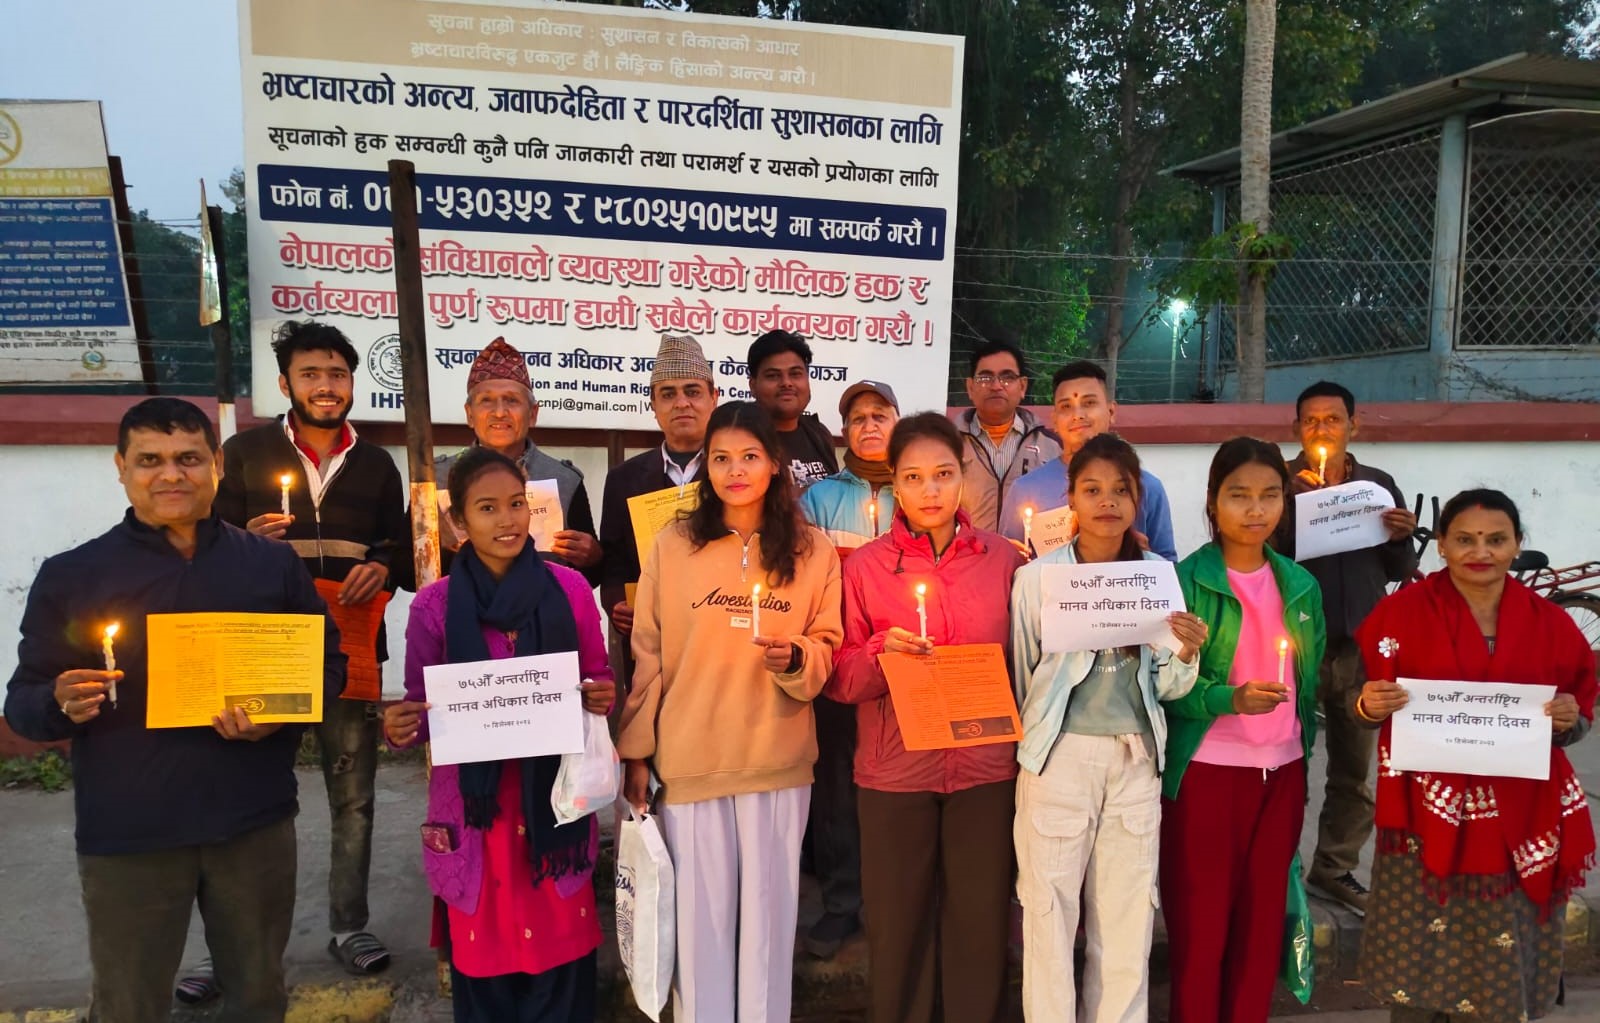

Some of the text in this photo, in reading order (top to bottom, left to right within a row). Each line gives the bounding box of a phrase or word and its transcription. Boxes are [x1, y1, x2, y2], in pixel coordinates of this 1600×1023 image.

[426, 14, 475, 34] सूचना
[480, 15, 515, 35] हाम्रो
[521, 17, 584, 39] अधिकार
[601, 27, 660, 48] सुशासन
[665, 32, 678, 46] र
[682, 29, 750, 52] विकासको
[756, 38, 801, 56] आधार
[523, 49, 577, 71] एकजुट
[670, 56, 723, 79] हिंसाको
[729, 65, 776, 82] अन्त्य
[262, 72, 944, 146] भ्रष्टाचारको अन्त्य, जवाफदेहिता र पारदर्शिता सुशासनका लागि
[268, 125, 348, 150] सूचनाको
[354, 132, 389, 153] हक
[473, 134, 509, 163] कुनै
[515, 137, 550, 160] पनि
[556, 143, 633, 167] जानकारी
[640, 149, 676, 169] तथा
[683, 151, 745, 174] परामर्श
[750, 156, 762, 175] र
[768, 157, 820, 180] यसको
[825, 160, 893, 185] प्रयोगका
[900, 166, 939, 188] लागि
[270, 179, 322, 207] फोन
[329, 183, 353, 210] नं.
[563, 192, 585, 224] र
[594, 196, 778, 239] ९८०२५१०९९५
[789, 216, 813, 238] मा
[819, 216, 881, 242] सम्पर्क
[419, 240, 553, 280] संविधानले
[558, 252, 663, 286] व्यवस्था
[668, 253, 749, 288] गरेको
[755, 257, 849, 295] मौलिक
[854, 270, 901, 301] हक
[908, 275, 930, 302] र
[428, 287, 480, 327] पुर्ण
[574, 293, 639, 329] हामी
[645, 296, 716, 333] सबैले
[558, 347, 625, 372] अधिकार
[554, 377, 577, 390] and
[582, 382, 626, 394] Human
[630, 383, 650, 397] Rig
[728, 387, 754, 399] Cen
[537, 398, 637, 413] cnpj@gmail.com
[1044, 536, 1064, 547] मानव
[1105, 572, 1157, 591] अन्तर्राष्ट्रिय
[1059, 598, 1170, 612] मानव अधिकार दिवस
[495, 670, 550, 686] अन्तर्राष्ट्रिय
[448, 692, 562, 713] मानव अधिकार दिवस
[1463, 692, 1521, 708] अन्तर्राष्ट्रिय
[1412, 712, 1530, 729] मानव अधिकार दिवस
